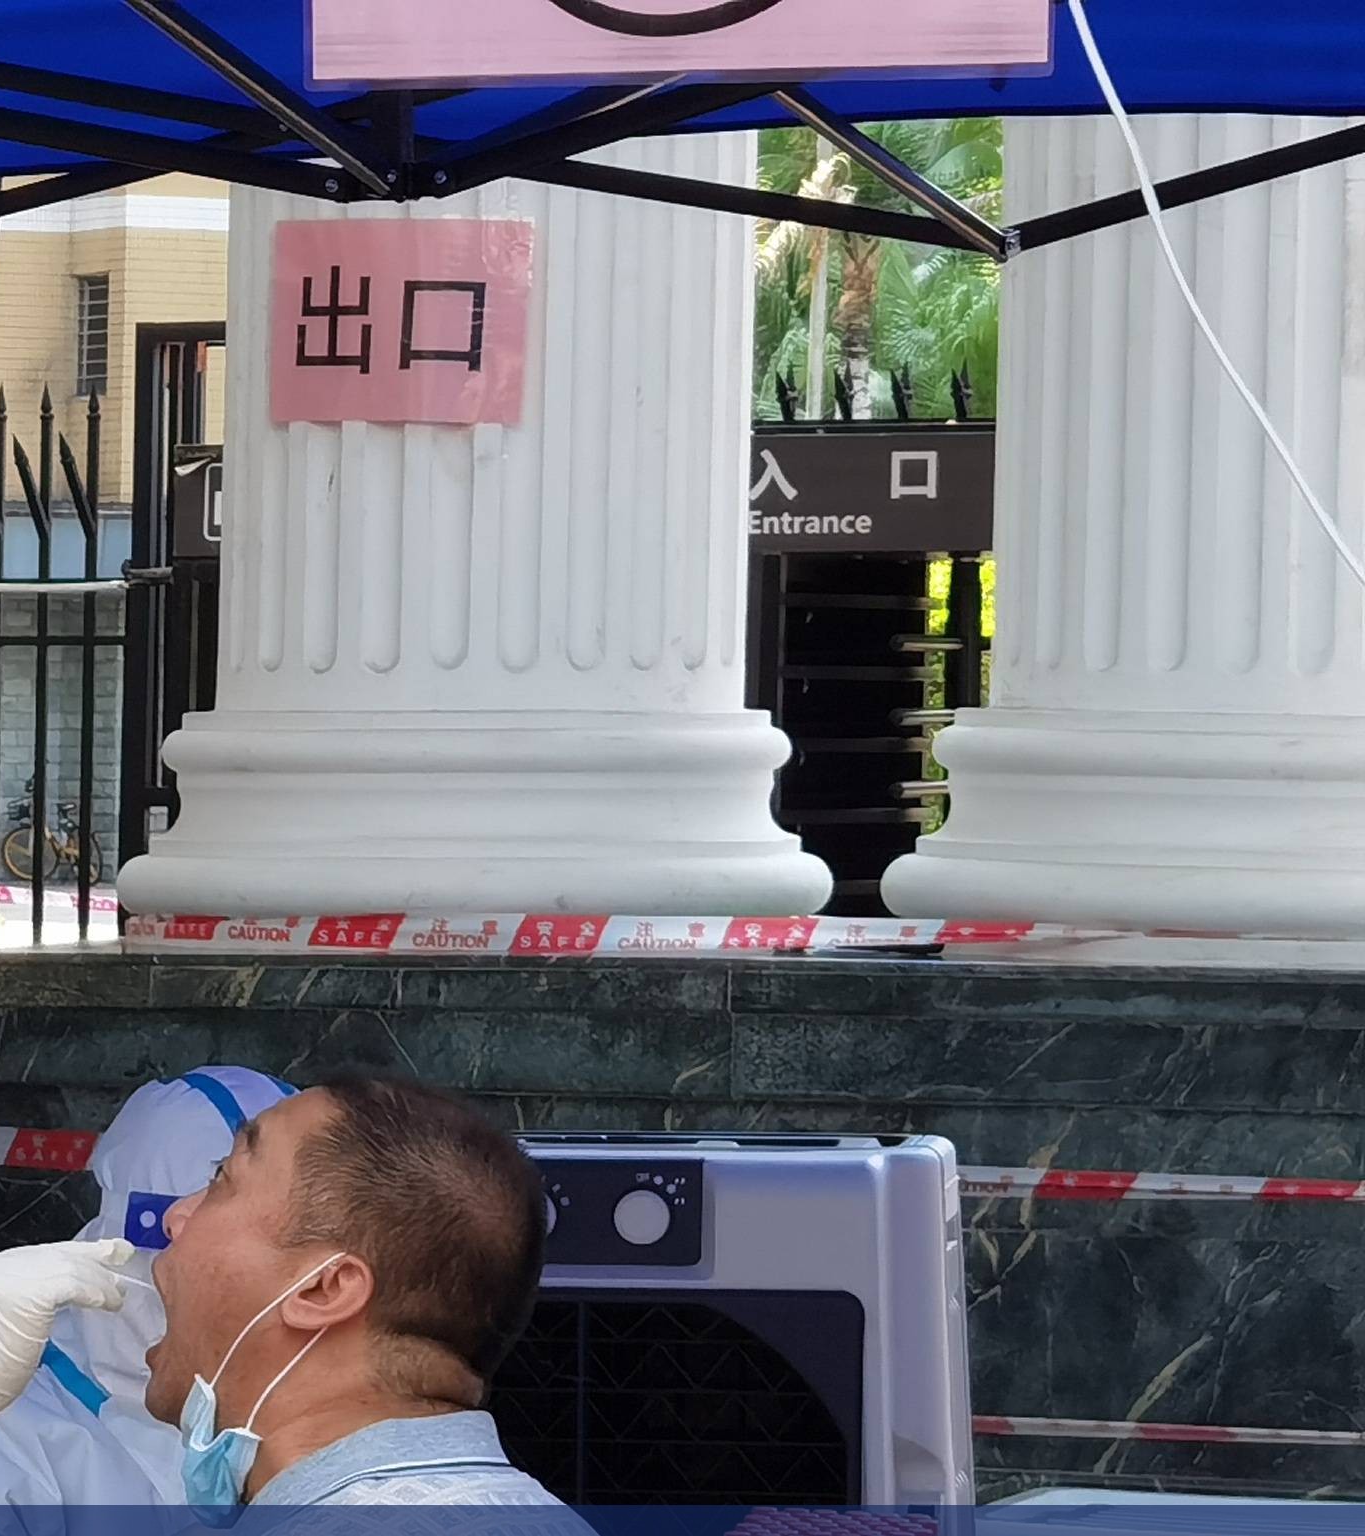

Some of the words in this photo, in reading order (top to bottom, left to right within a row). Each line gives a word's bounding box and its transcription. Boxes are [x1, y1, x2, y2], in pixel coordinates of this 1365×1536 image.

[295, 264, 487, 375] 出口
[749, 449, 938, 500] 入口
[748, 510, 873, 534] Entrance
[228, 926, 291, 942] CAUTION
[318, 929, 383, 946] SAFE
[412, 932, 490, 948] CAUTION
[520, 935, 588, 949] SAFE
[618, 937, 697, 950] CAUTION
